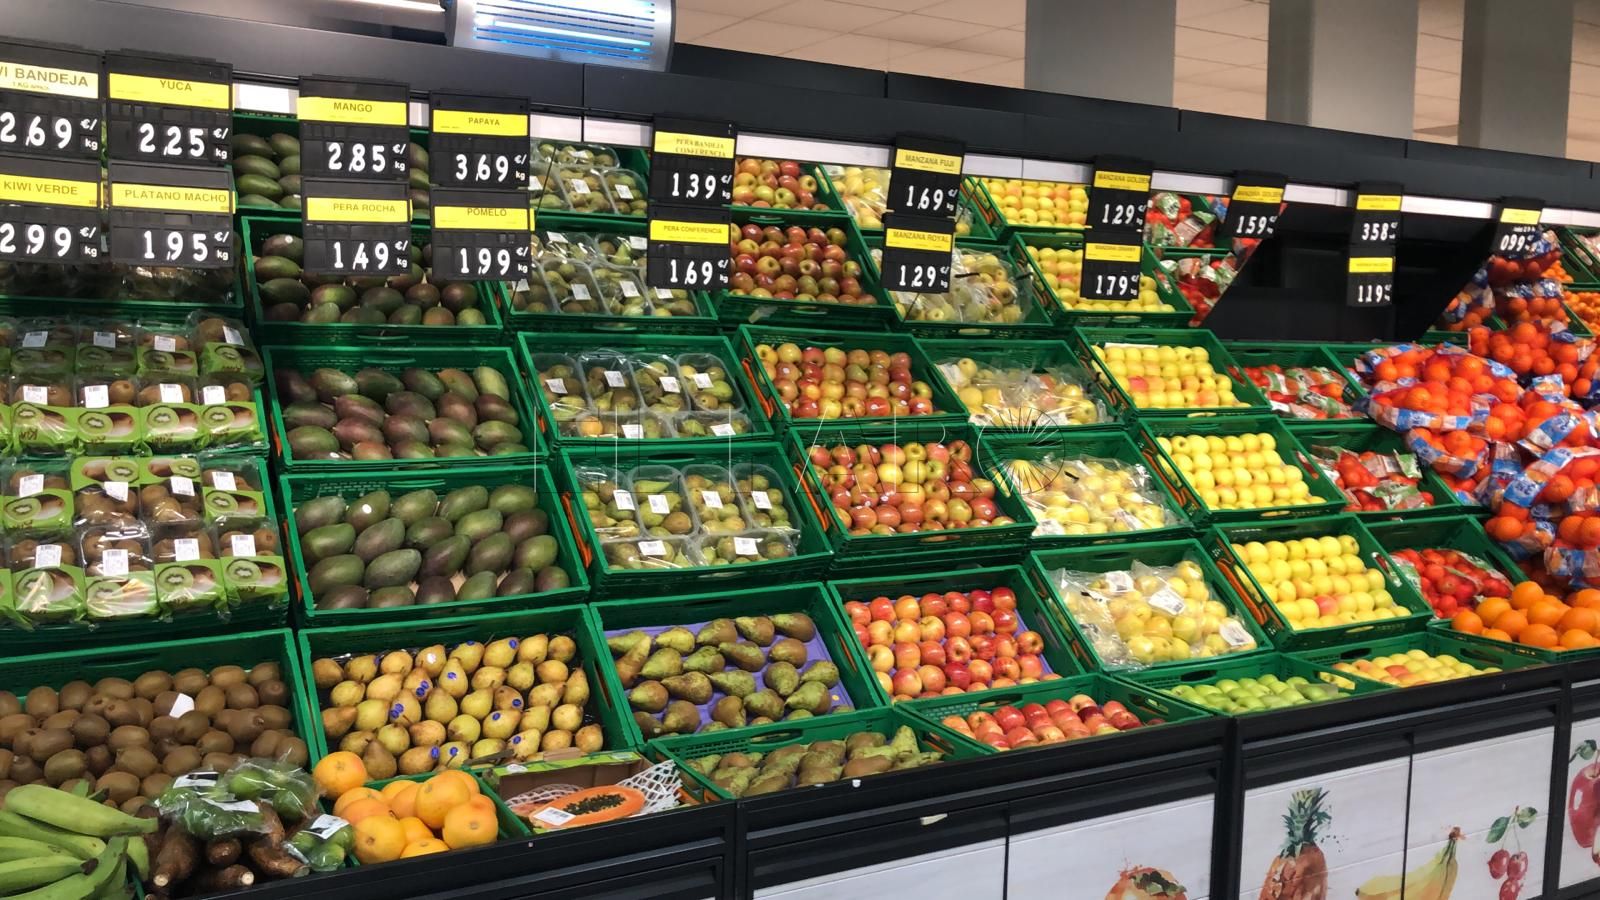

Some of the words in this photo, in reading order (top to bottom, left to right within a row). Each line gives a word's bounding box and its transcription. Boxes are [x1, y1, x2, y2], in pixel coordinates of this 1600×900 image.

[15, 68, 89, 87] BANDEJA
[159, 79, 193, 92] YUCA
[333, 102, 373, 113] MANGO
[468, 116, 500, 126] PAPAYA
[84, 138, 98, 152] kg
[215, 148, 228, 159] kg
[675, 147, 726, 157] CONFERENCIA
[394, 160, 406, 171] kg
[905, 154, 939, 166] MANZANA
[939, 158, 955, 168] FUJI
[515, 170, 526, 181] kg
[4, 179, 33, 192] KIWI
[35, 183, 79, 196] VERDE
[124, 188, 182, 202] PLATANO
[184, 191, 228, 204] MACHO
[333, 203, 361, 212] PERA
[362, 203, 397, 214] ROCHA
[467, 207, 508, 217] POMELO
[663, 224, 680, 233] PERA
[680, 225, 723, 235] CONFERENCIA
[893, 231, 926, 242] MANZANA
[926, 234, 949, 244] ROYAL
[84, 246, 98, 258] kg
[216, 249, 229, 261] kg
[396, 257, 408, 269] kg
[517, 263, 528, 274] kg
